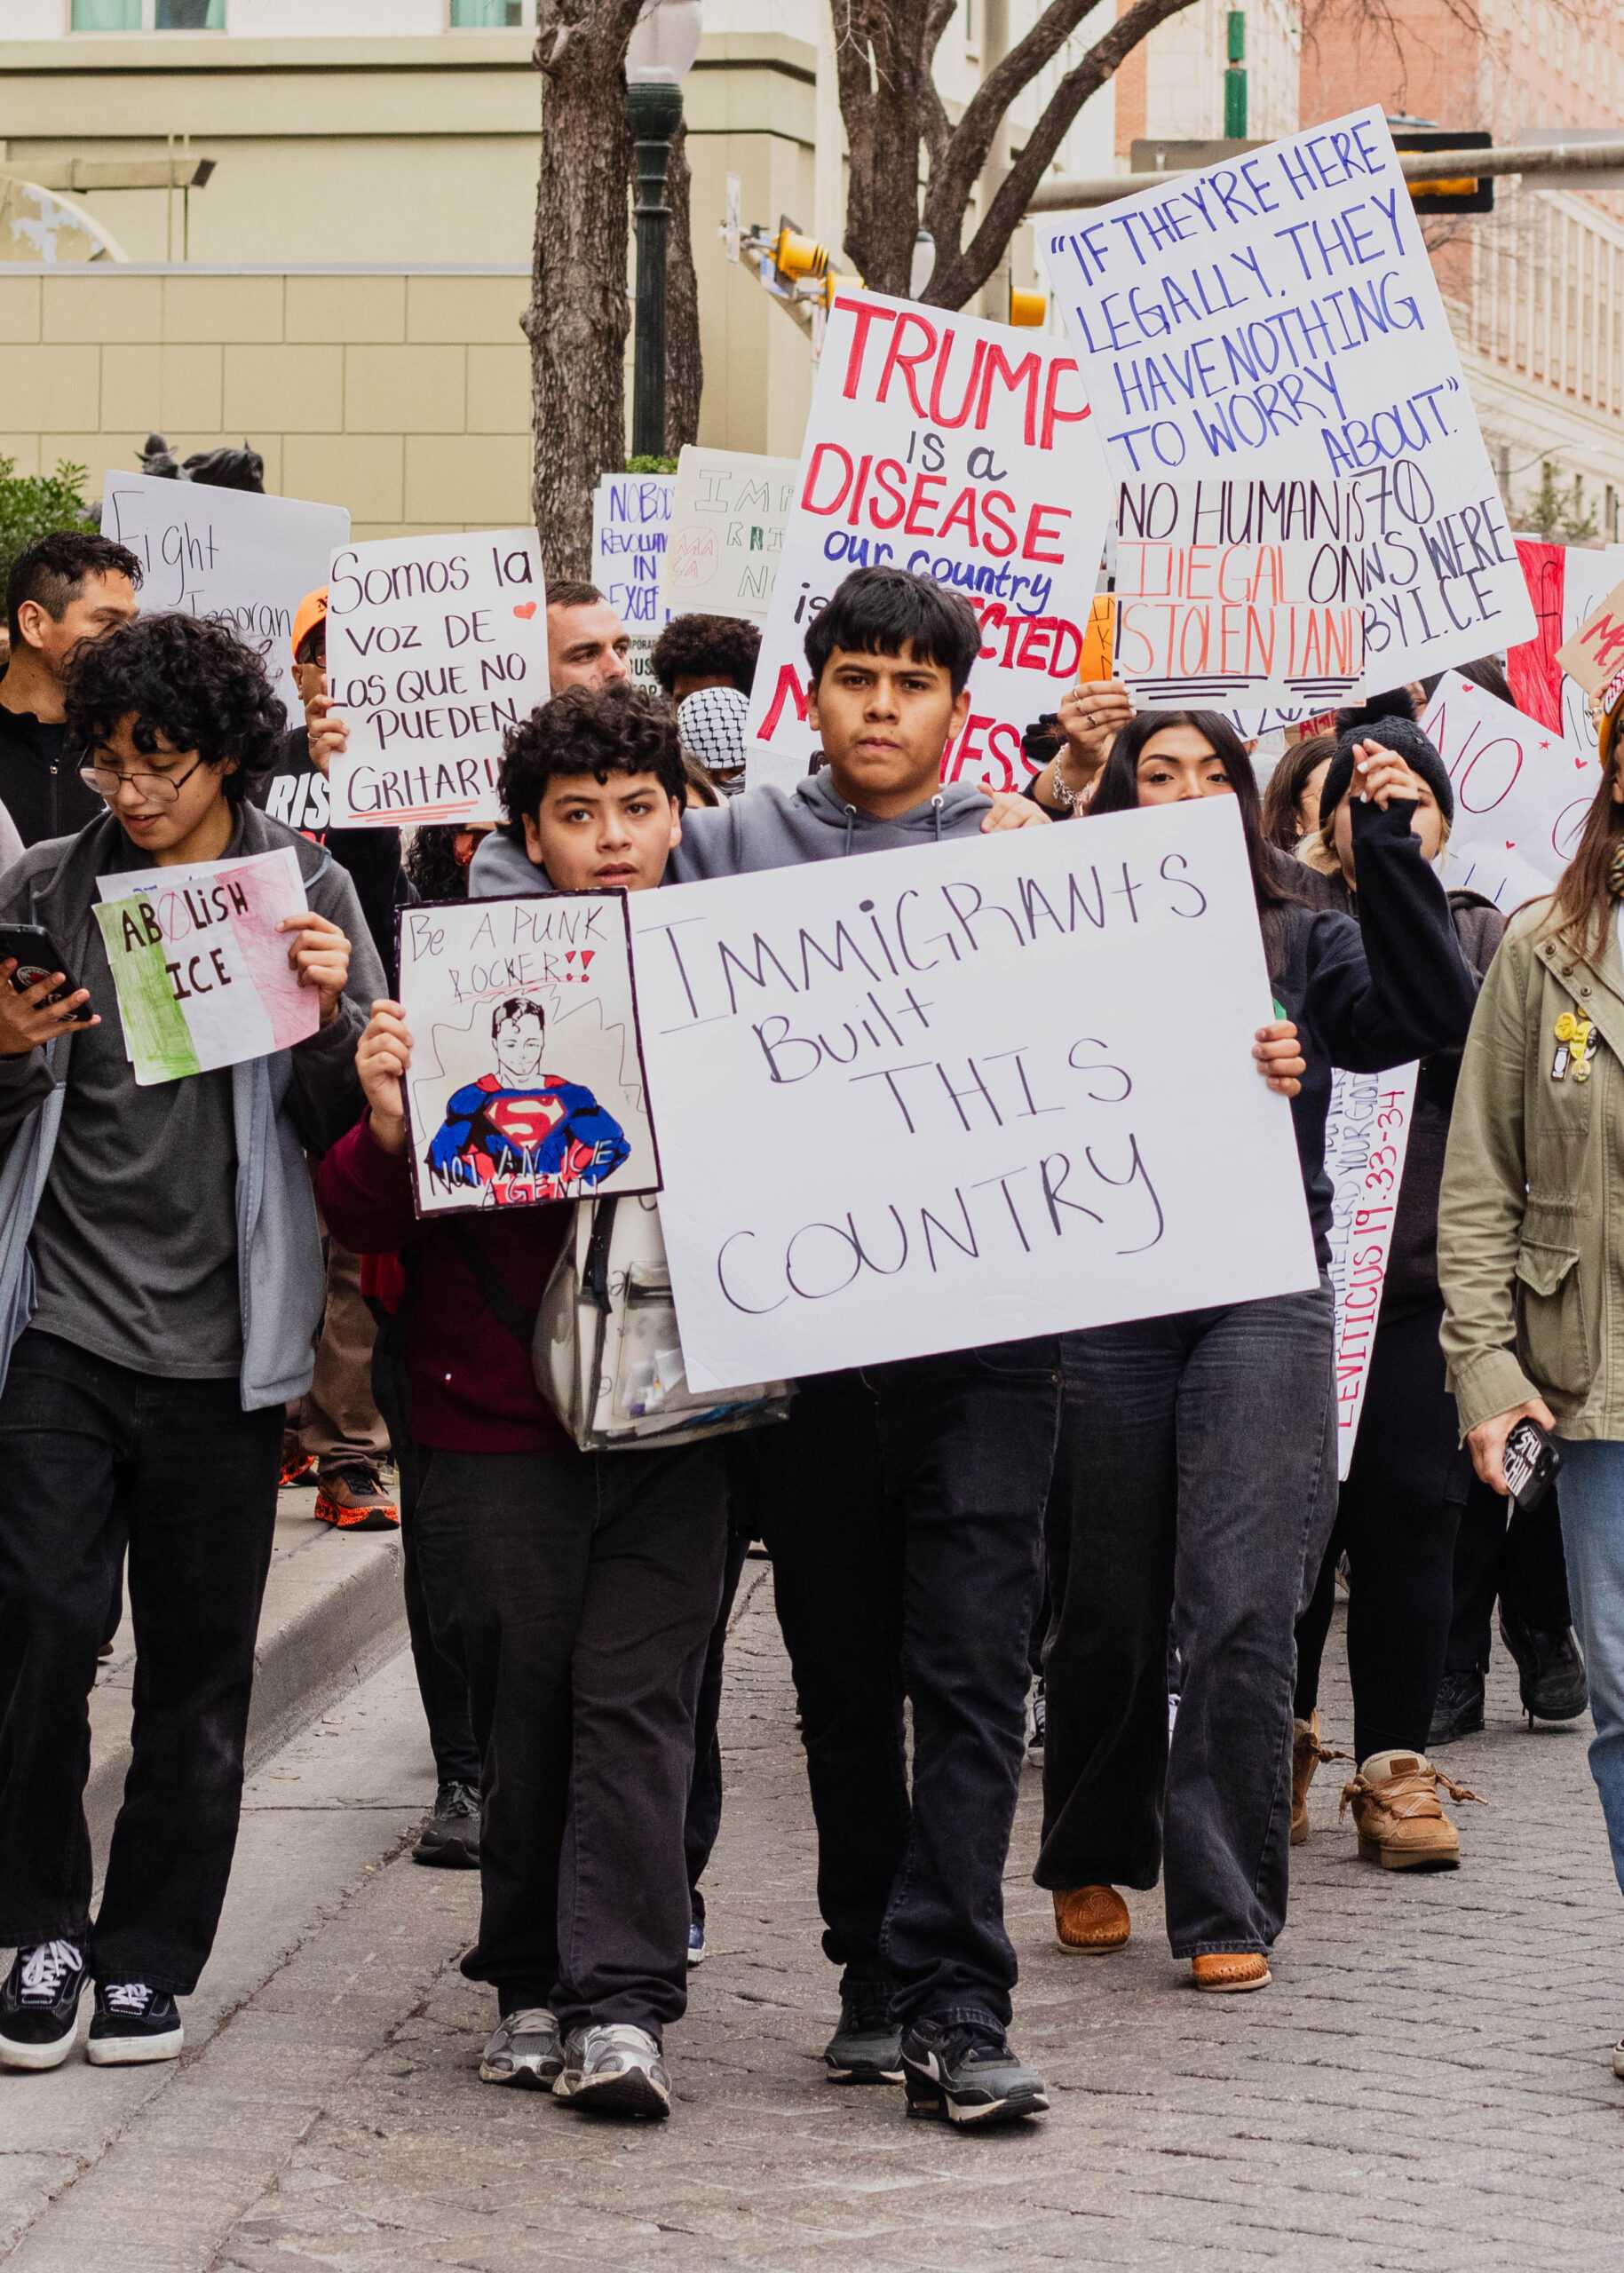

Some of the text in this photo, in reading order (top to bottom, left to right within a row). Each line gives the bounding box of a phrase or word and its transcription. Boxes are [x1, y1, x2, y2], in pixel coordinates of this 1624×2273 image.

[1110, 159, 1279, 265] THEY'RE
[1278, 119, 1387, 201] HERE
[1273, 187, 1406, 281] THEY
[834, 297, 1092, 451] TRUMP
[1106, 360, 1348, 472] TO WORRY
[966, 445, 1009, 482] a
[800, 442, 1073, 566] DISEASE
[1118, 480, 1179, 540] NO
[1192, 479, 1340, 546] HUMAN
[112, 490, 219, 606] Fight
[633, 554, 657, 582] IN
[1418, 496, 1518, 581] WERE
[330, 550, 470, 615] Somos
[492, 547, 534, 587] la
[823, 530, 1052, 617] our country
[1308, 543, 1366, 605] ON
[444, 609, 496, 649] DE
[330, 652, 527, 709] LOS QUE NO
[365, 697, 520, 750] PUEDEN
[408, 905, 608, 962] Be A PUNK
[165, 947, 233, 1002] ICE
[848, 1037, 1132, 1135] THIS
[428, 1139, 615, 1197] NOT AN ICE
[1335, 1120, 1374, 1176] YOUR
[717, 1132, 1164, 1315] COUNTRY
[1335, 1245, 1384, 1428] LEVITICUS
